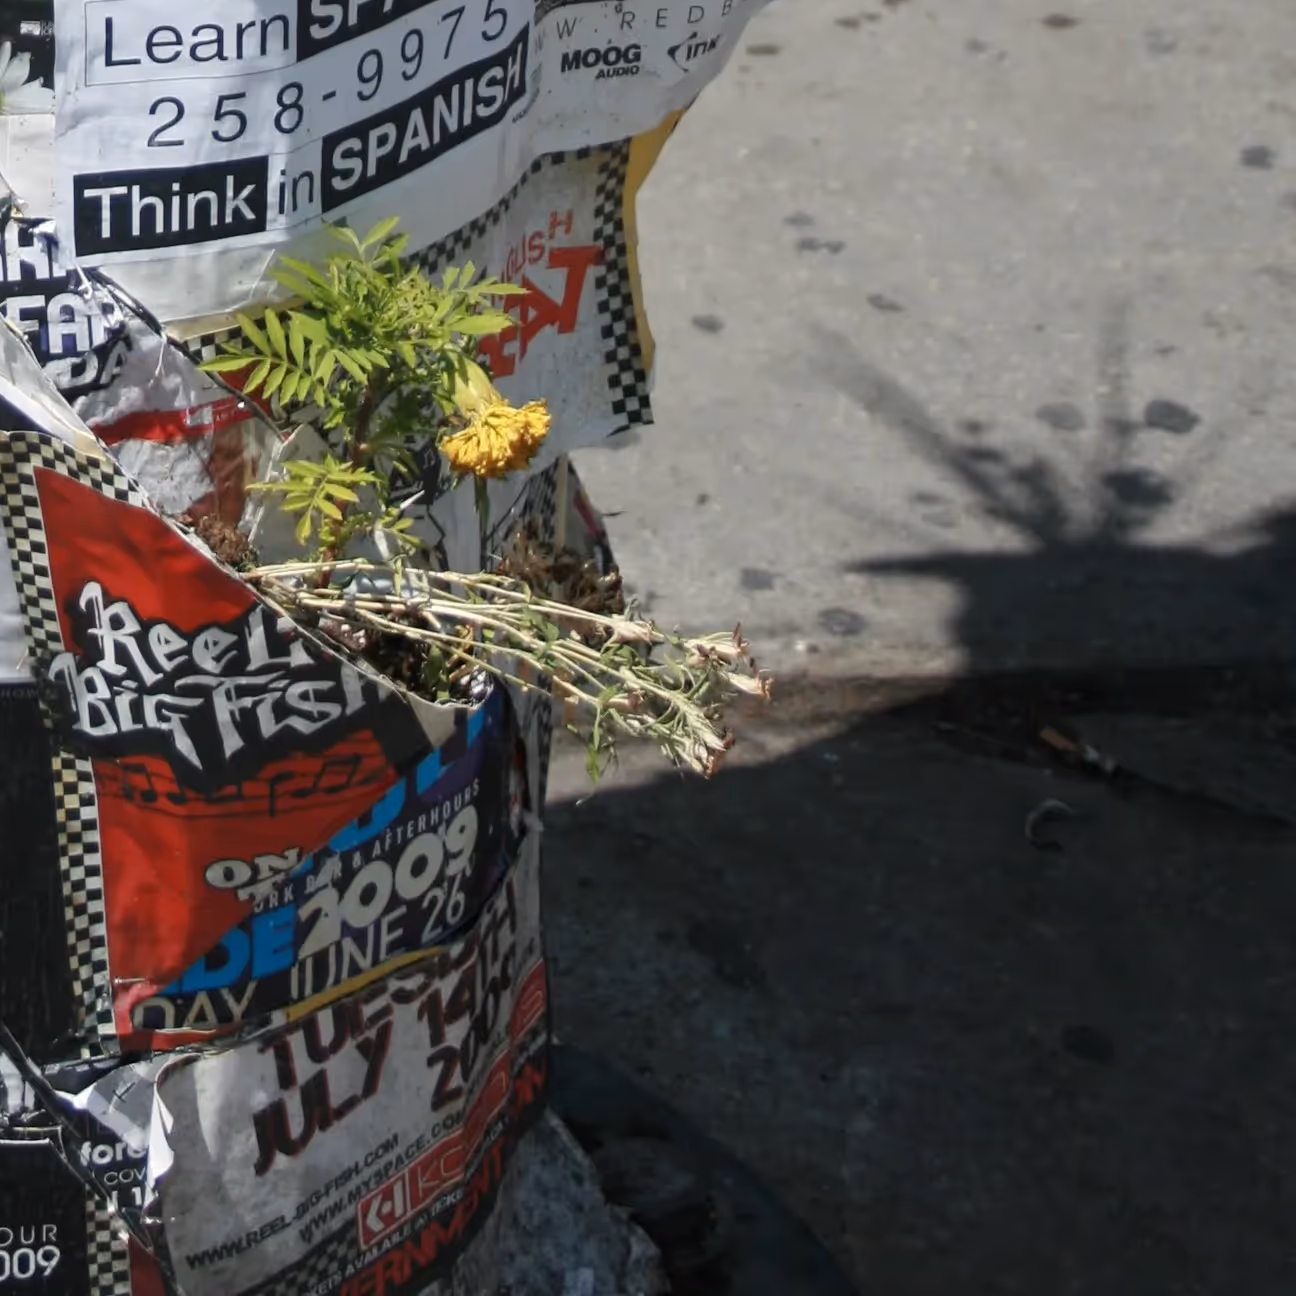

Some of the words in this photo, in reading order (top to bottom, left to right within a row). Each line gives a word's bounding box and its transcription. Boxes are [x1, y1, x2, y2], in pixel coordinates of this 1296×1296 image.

[102, 10, 292, 69] Learn
[560, 42, 642, 74] MOOG
[594, 64, 641, 81] AUDIO
[83, 174, 259, 240] Think
[277, 165, 318, 217] in
[329, 36, 527, 194] SPANISH
[420, 871, 466, 945] 26
[252, 1008, 395, 1177] JULY
